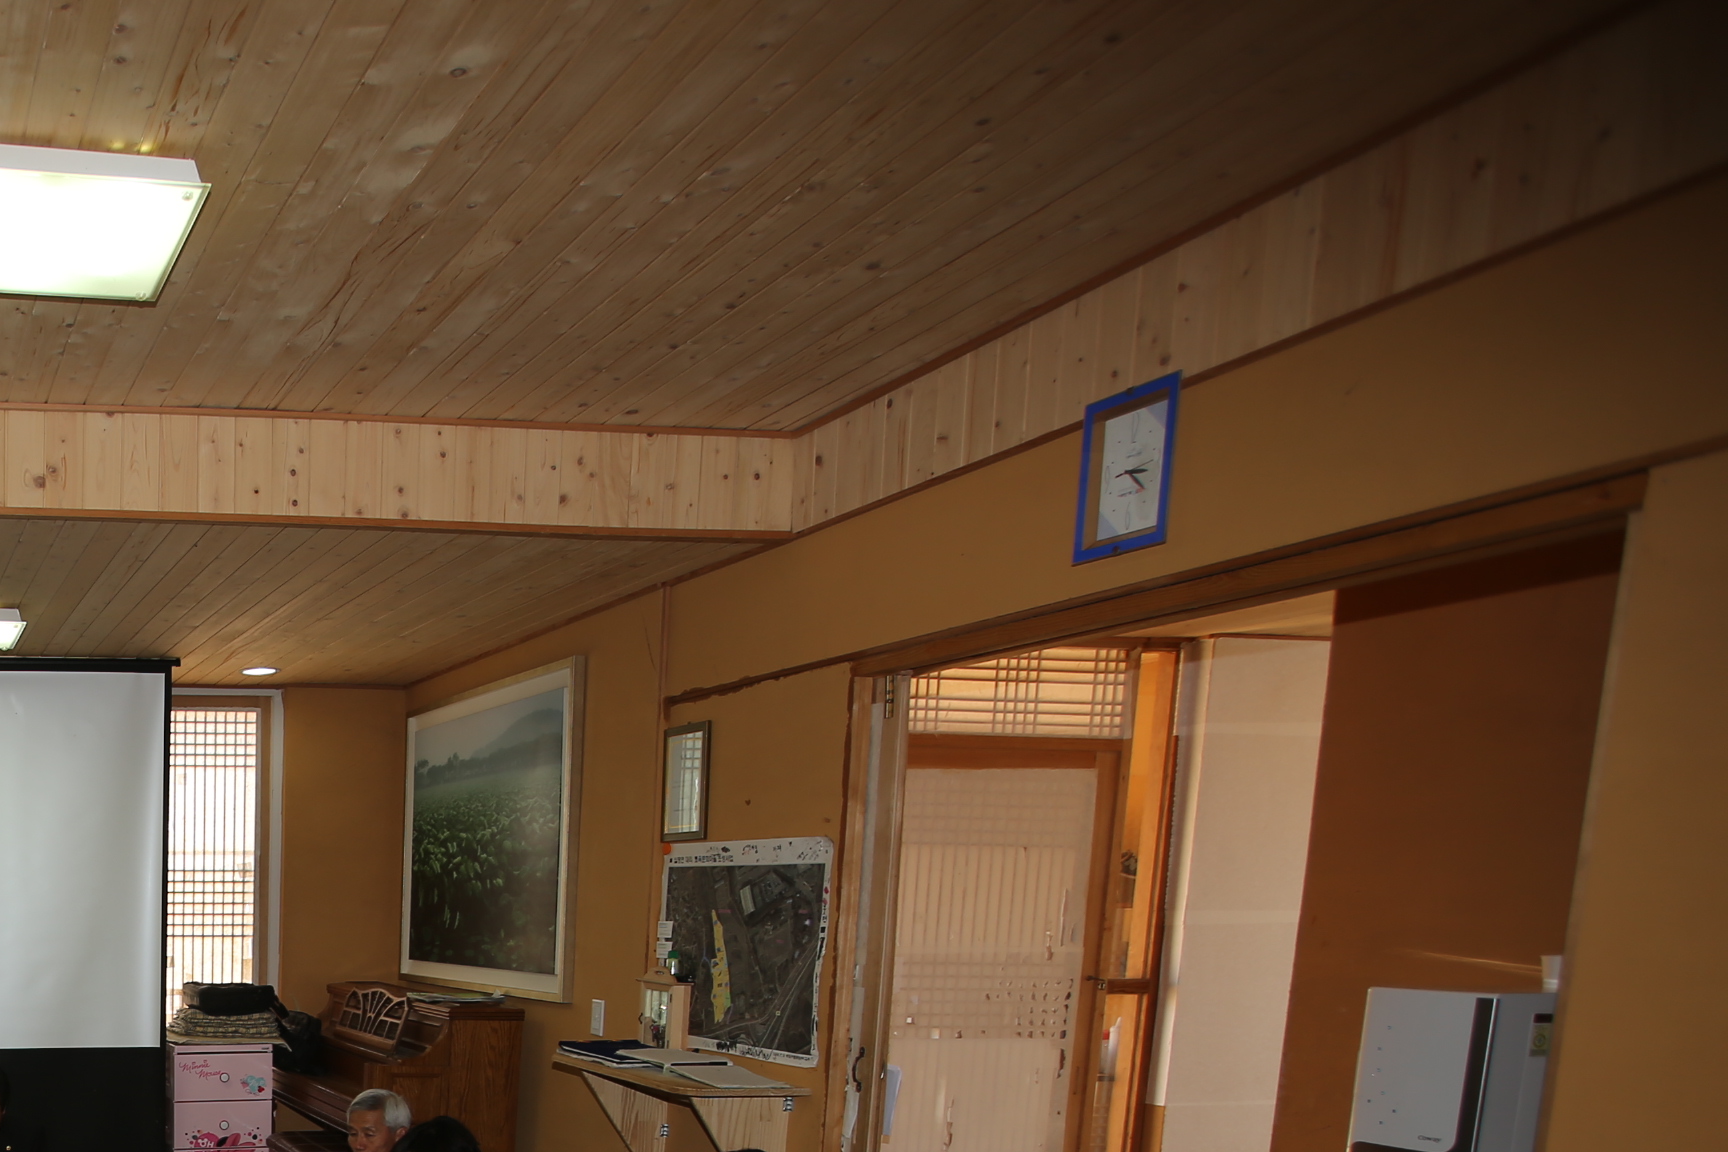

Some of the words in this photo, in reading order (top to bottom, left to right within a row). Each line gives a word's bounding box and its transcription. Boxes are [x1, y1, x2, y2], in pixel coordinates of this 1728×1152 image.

[179, 1059, 210, 1073] Minnie
[195, 1069, 223, 1081] Mouse
[198, 1138, 214, 1148] OH
